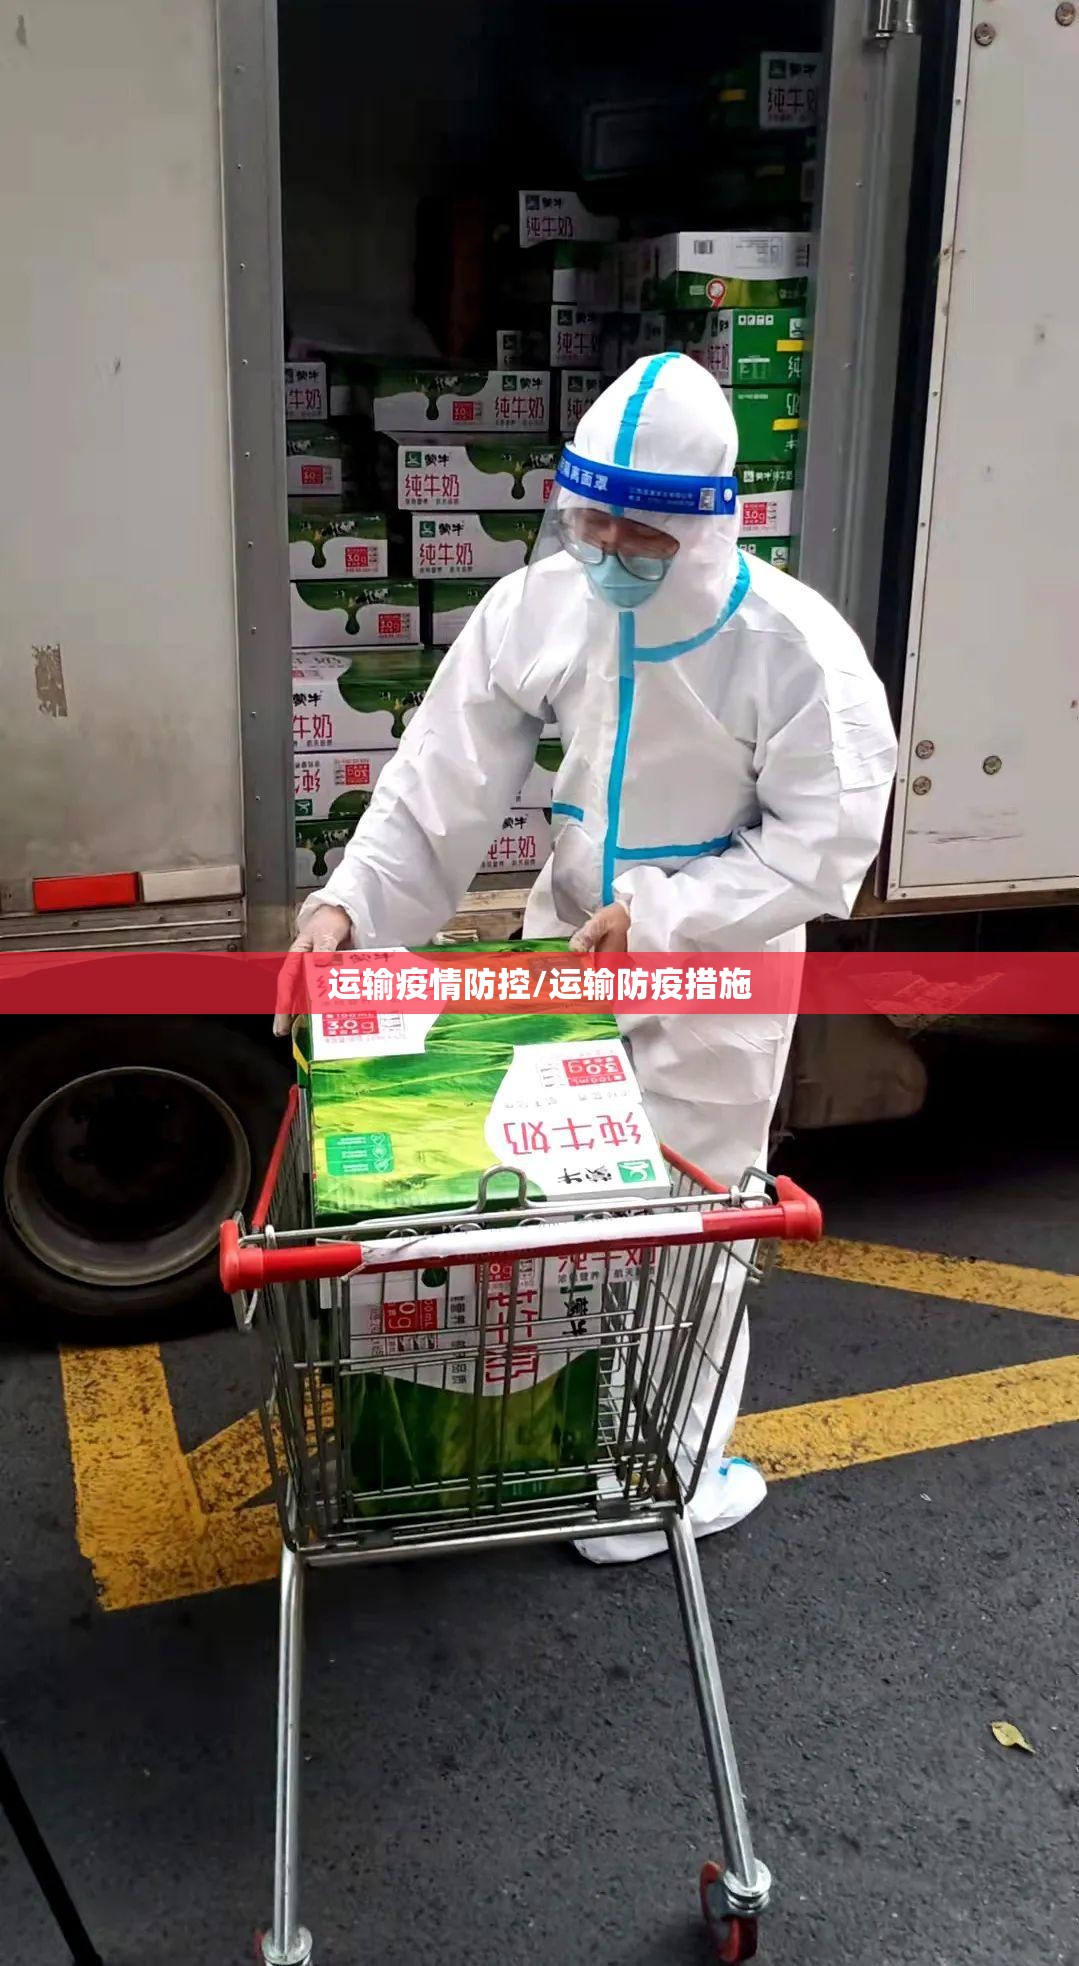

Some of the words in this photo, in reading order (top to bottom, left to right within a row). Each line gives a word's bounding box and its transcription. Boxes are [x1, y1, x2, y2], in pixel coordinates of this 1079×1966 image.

[495, 397, 544, 419] 纯牛奶
[425, 454, 449, 467] 蒙牛
[405, 474, 460, 497] 纯牛奶
[439, 523, 463, 536] 蒙牛
[419, 542, 473, 566] 纯牛奶
[292, 714, 332, 740] 牛奶
[503, 1112, 642, 1155] 纯牛奶
[557, 1165, 613, 1184] 蒙牛
